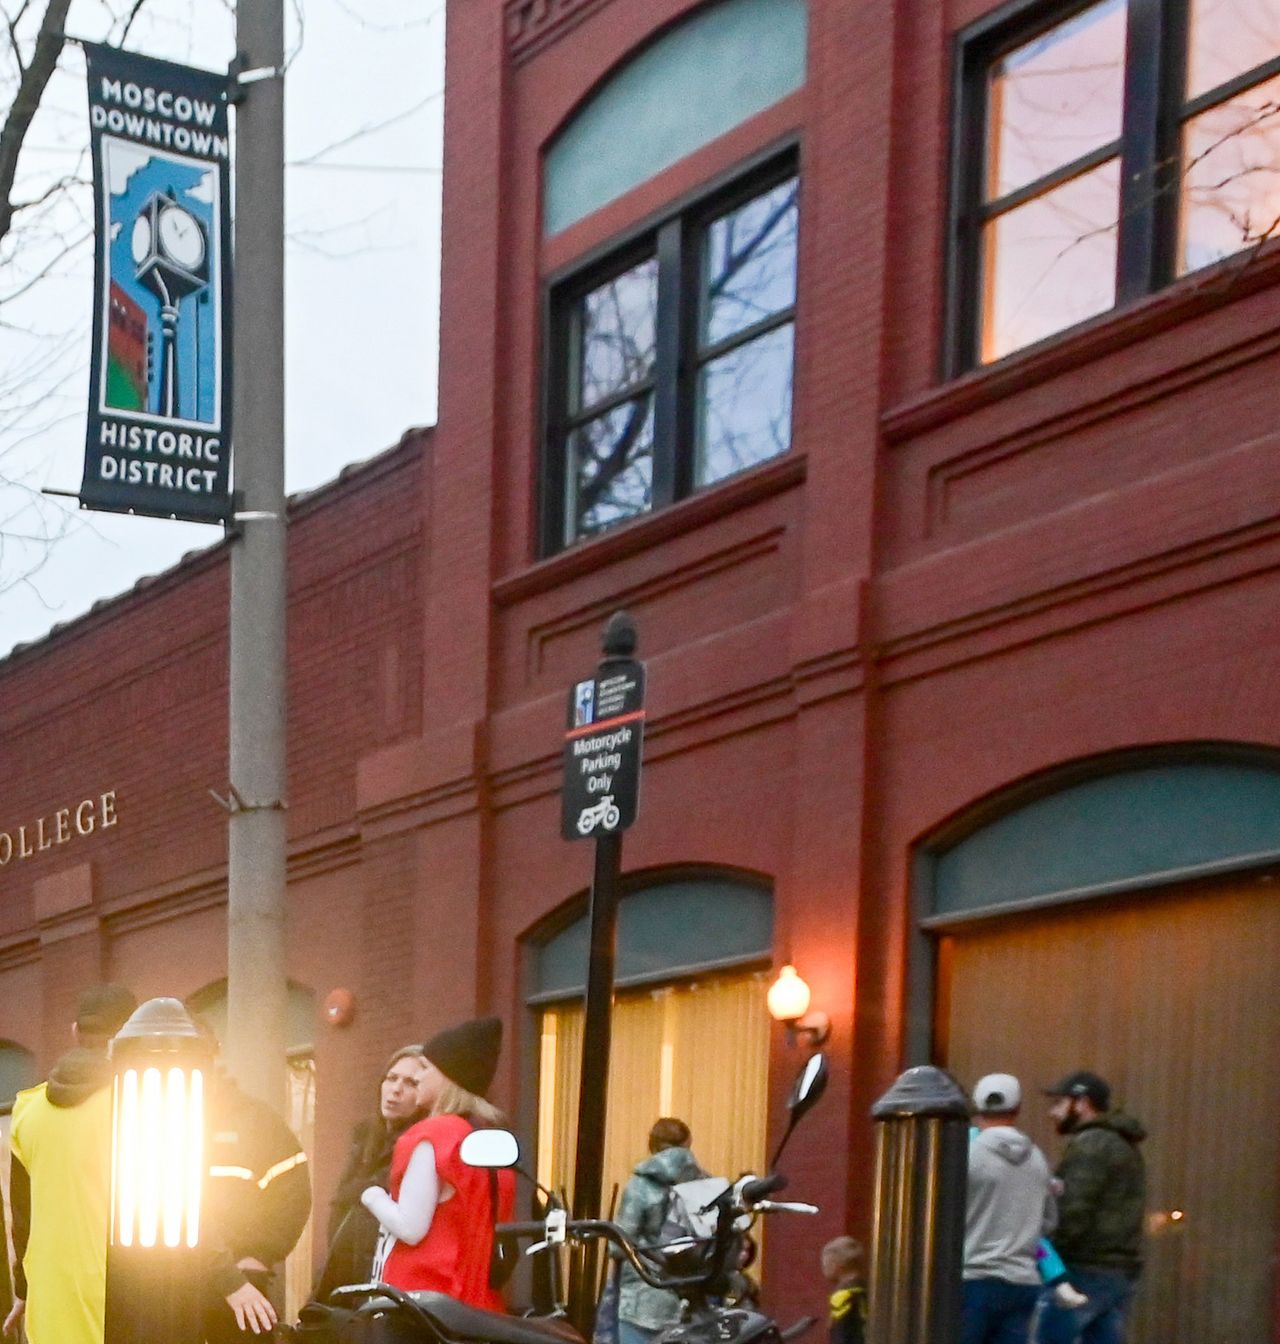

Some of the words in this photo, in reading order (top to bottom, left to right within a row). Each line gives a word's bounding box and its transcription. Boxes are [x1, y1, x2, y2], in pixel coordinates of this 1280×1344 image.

[101, 76, 216, 127] MOSCOW
[92, 104, 228, 158] DOWNTOWN
[100, 421, 221, 463] HISTORIC
[100, 455, 218, 493] DISTRICT
[574, 728, 632, 756] Motorcycle
[582, 752, 621, 774] Parking
[589, 773, 613, 793] Only
